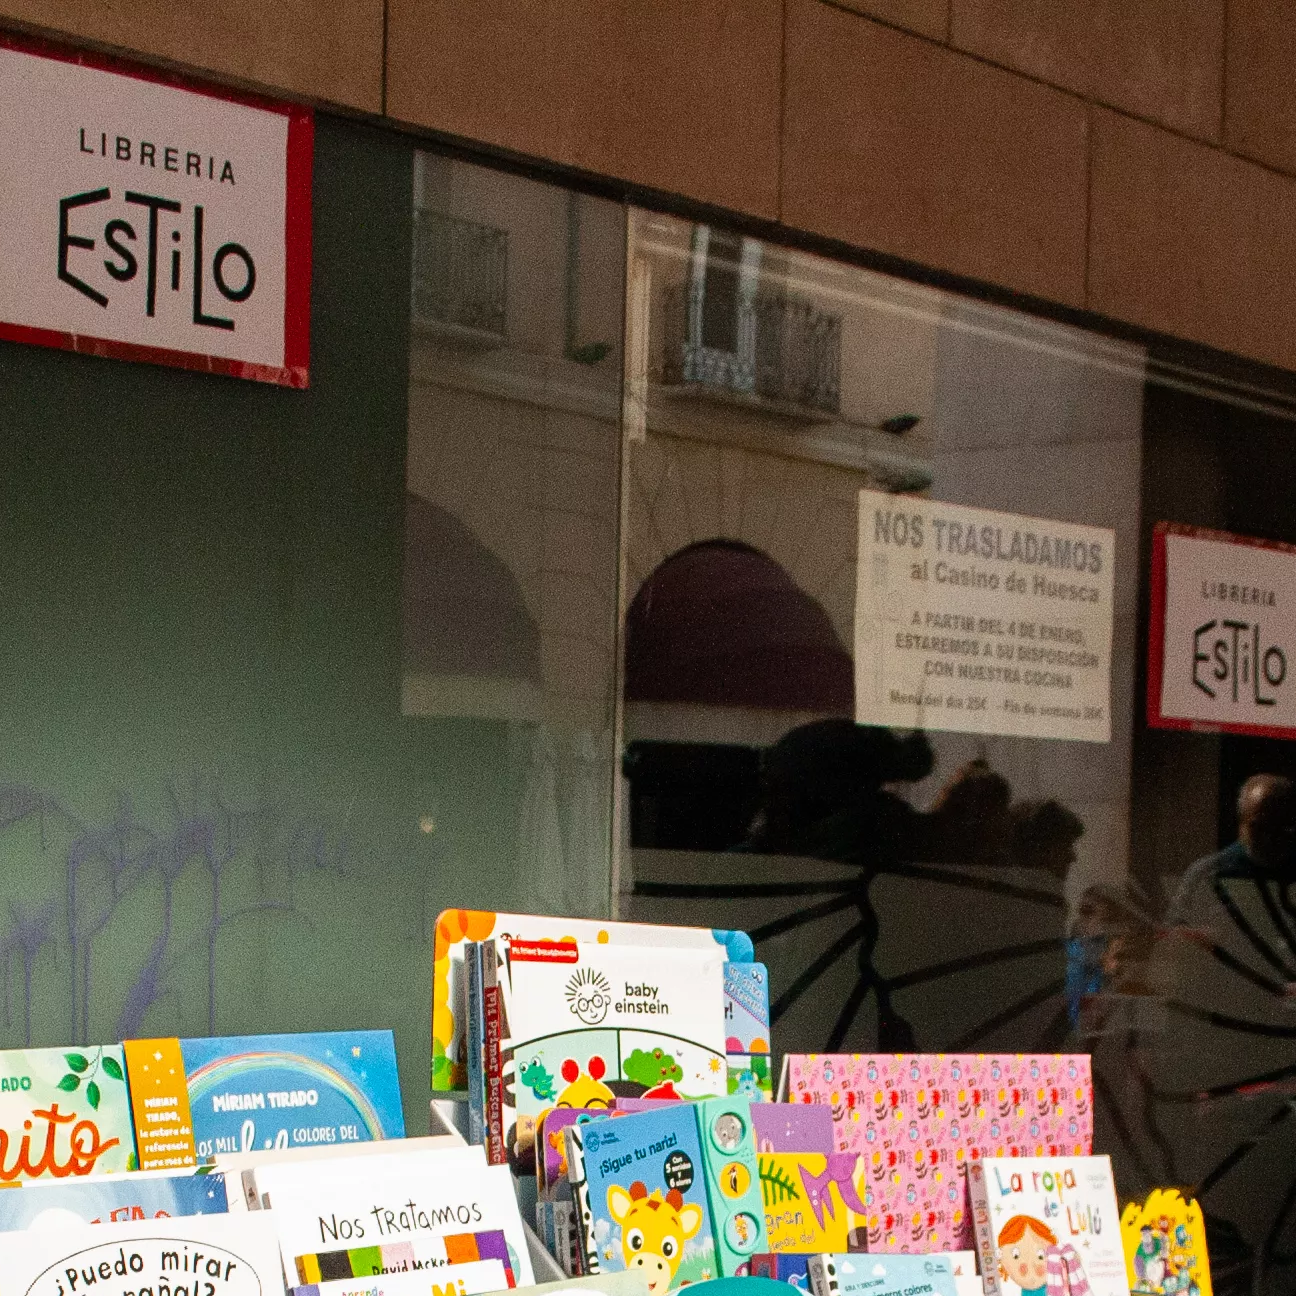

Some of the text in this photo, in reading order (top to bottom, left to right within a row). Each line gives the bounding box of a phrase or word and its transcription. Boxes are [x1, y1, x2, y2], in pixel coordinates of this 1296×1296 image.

[79, 127, 236, 185] LIBRERIA
[874, 510, 1103, 575] NOS TRASLADAMOS
[910, 559, 1100, 603] al Casino de Huesca
[911, 611, 922, 625] A
[926, 612, 975, 631] PARTIR
[979, 618, 1003, 635] DEL
[1019, 623, 1035, 639] DE
[895, 633, 979, 657] ESTAREMOS
[983, 642, 993, 657] A
[997, 643, 1014, 660] SU
[924, 660, 1073, 688] CON NUESTRA COCINA
[625, 982, 658, 998] baby
[615, 1000, 669, 1015] einstein
[213, 1090, 318, 1112] MÍRIAM TIRADO
[145, 1140, 189, 1153] referencia
[216, 1137, 237, 1153] MIL
[293, 1125, 359, 1142] COLORES DEL
[600, 1132, 678, 1178] ¡Sigue tu nariz!
[994, 1166, 1077, 1204] La ropa
[318, 1214, 364, 1243] Nos
[1066, 1200, 1102, 1237] Lulú
[161, 1246, 237, 1283] mirar
[904, 1283, 933, 1296] colores
